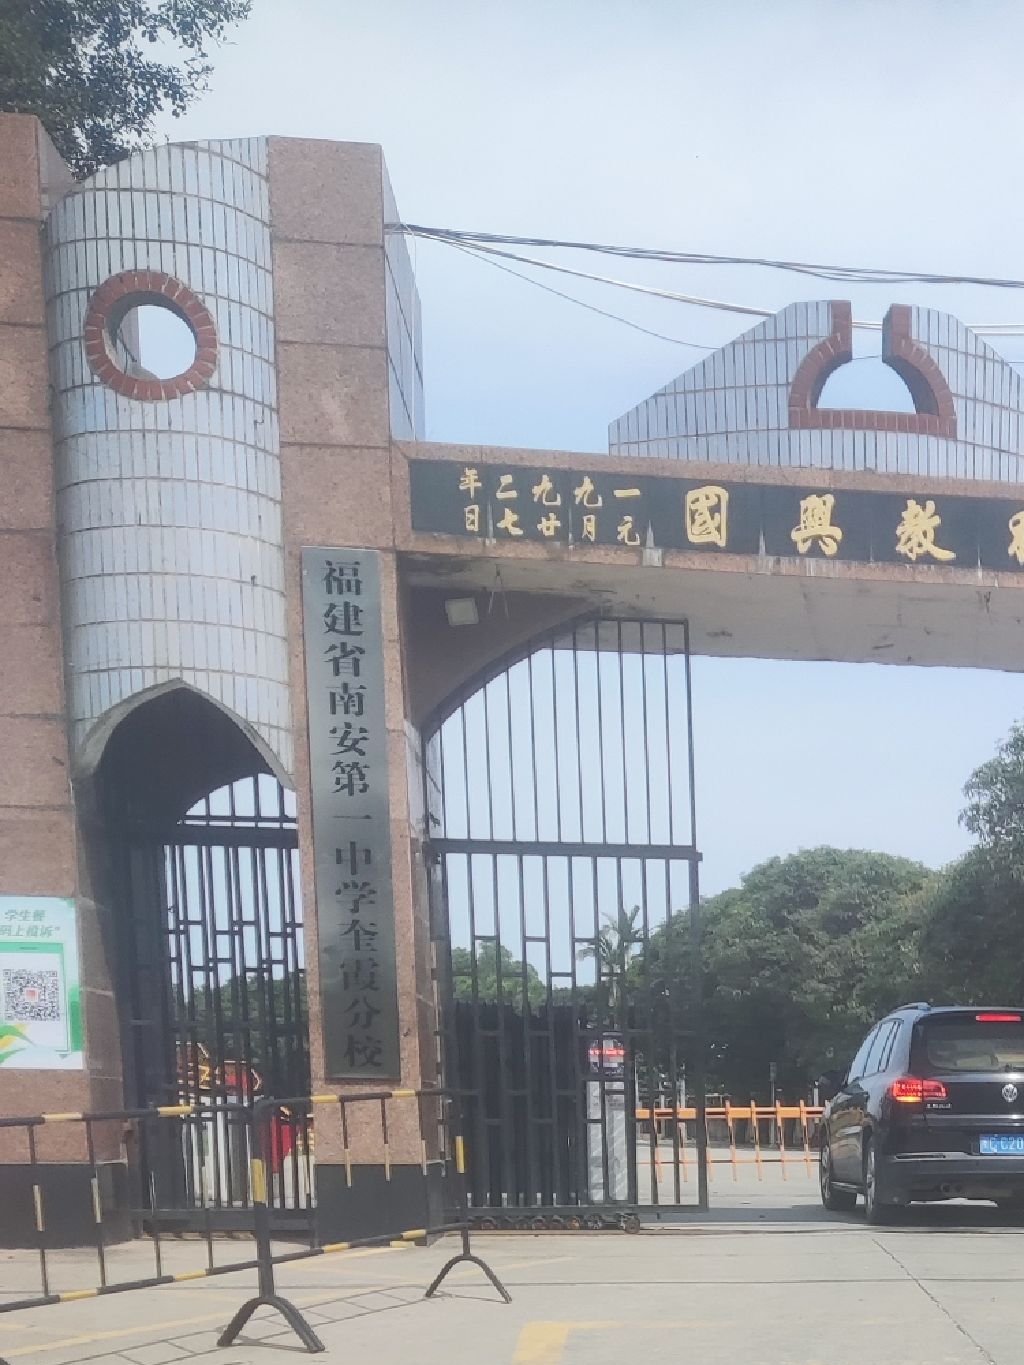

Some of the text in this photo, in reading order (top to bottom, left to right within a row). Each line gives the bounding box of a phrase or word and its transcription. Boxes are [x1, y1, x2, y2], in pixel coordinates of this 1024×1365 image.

[320, 559, 383, 1068] 福建省南安第一中学奎霞分校
